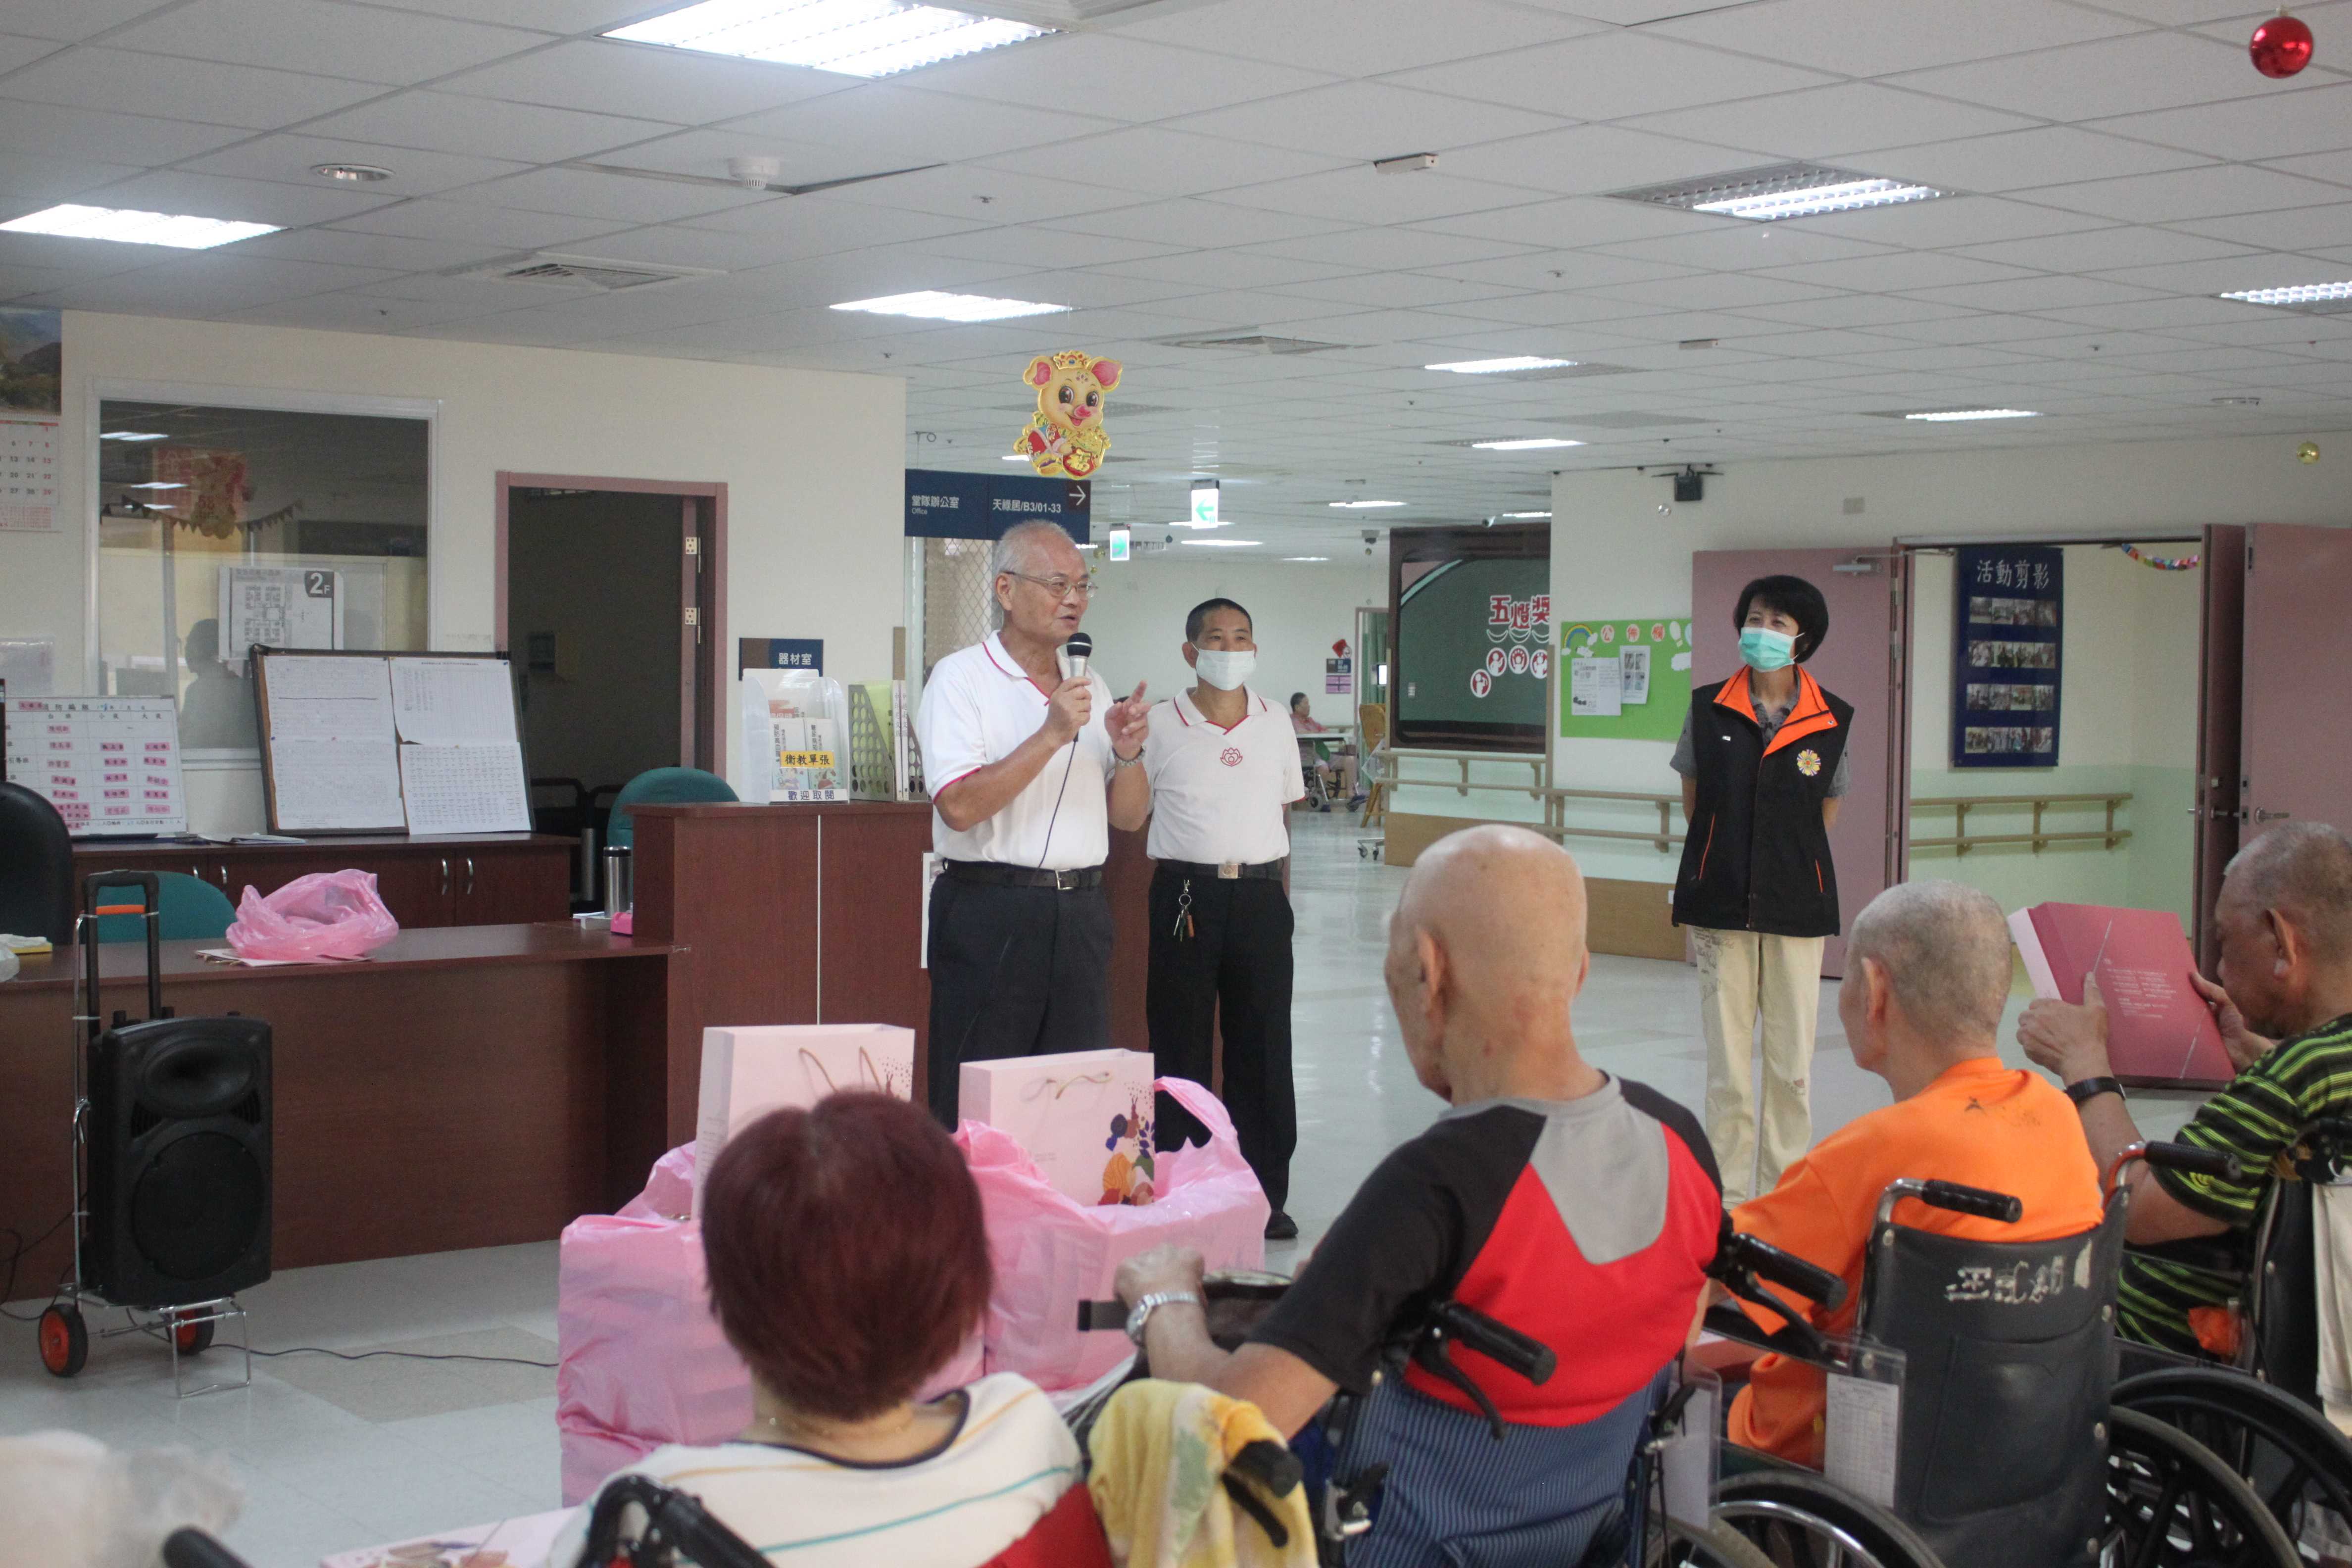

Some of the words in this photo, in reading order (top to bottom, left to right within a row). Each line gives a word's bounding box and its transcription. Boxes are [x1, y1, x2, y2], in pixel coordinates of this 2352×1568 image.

[1977, 559, 2049, 589] 活動剪影
[310, 573, 331, 594] 2F
[778, 652, 812, 665] 器材室
[787, 790, 835, 801] 歡迎取閱
